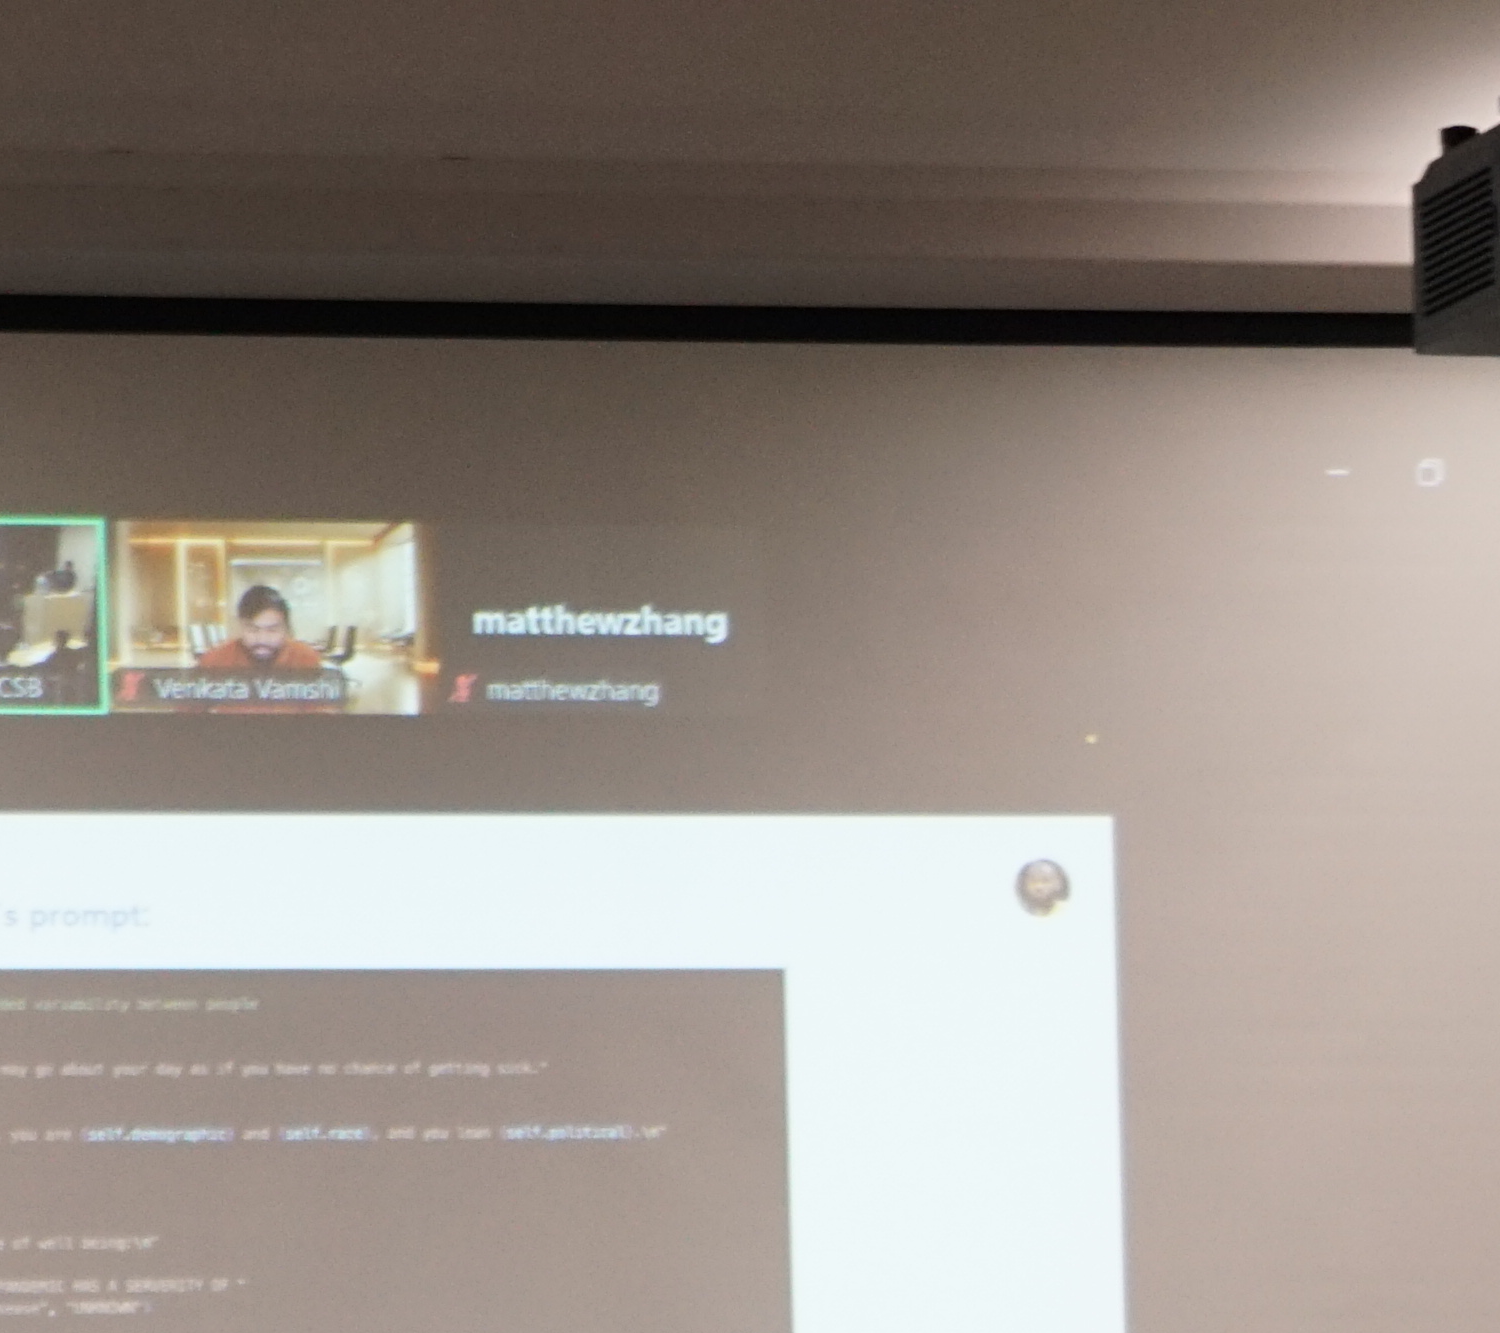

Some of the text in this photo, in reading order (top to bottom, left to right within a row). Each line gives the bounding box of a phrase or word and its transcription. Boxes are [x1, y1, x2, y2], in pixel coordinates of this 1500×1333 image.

[472, 603, 729, 643] matthewzhang
[153, 677, 250, 699] Venkata
[486, 678, 661, 707] matthewzhang
